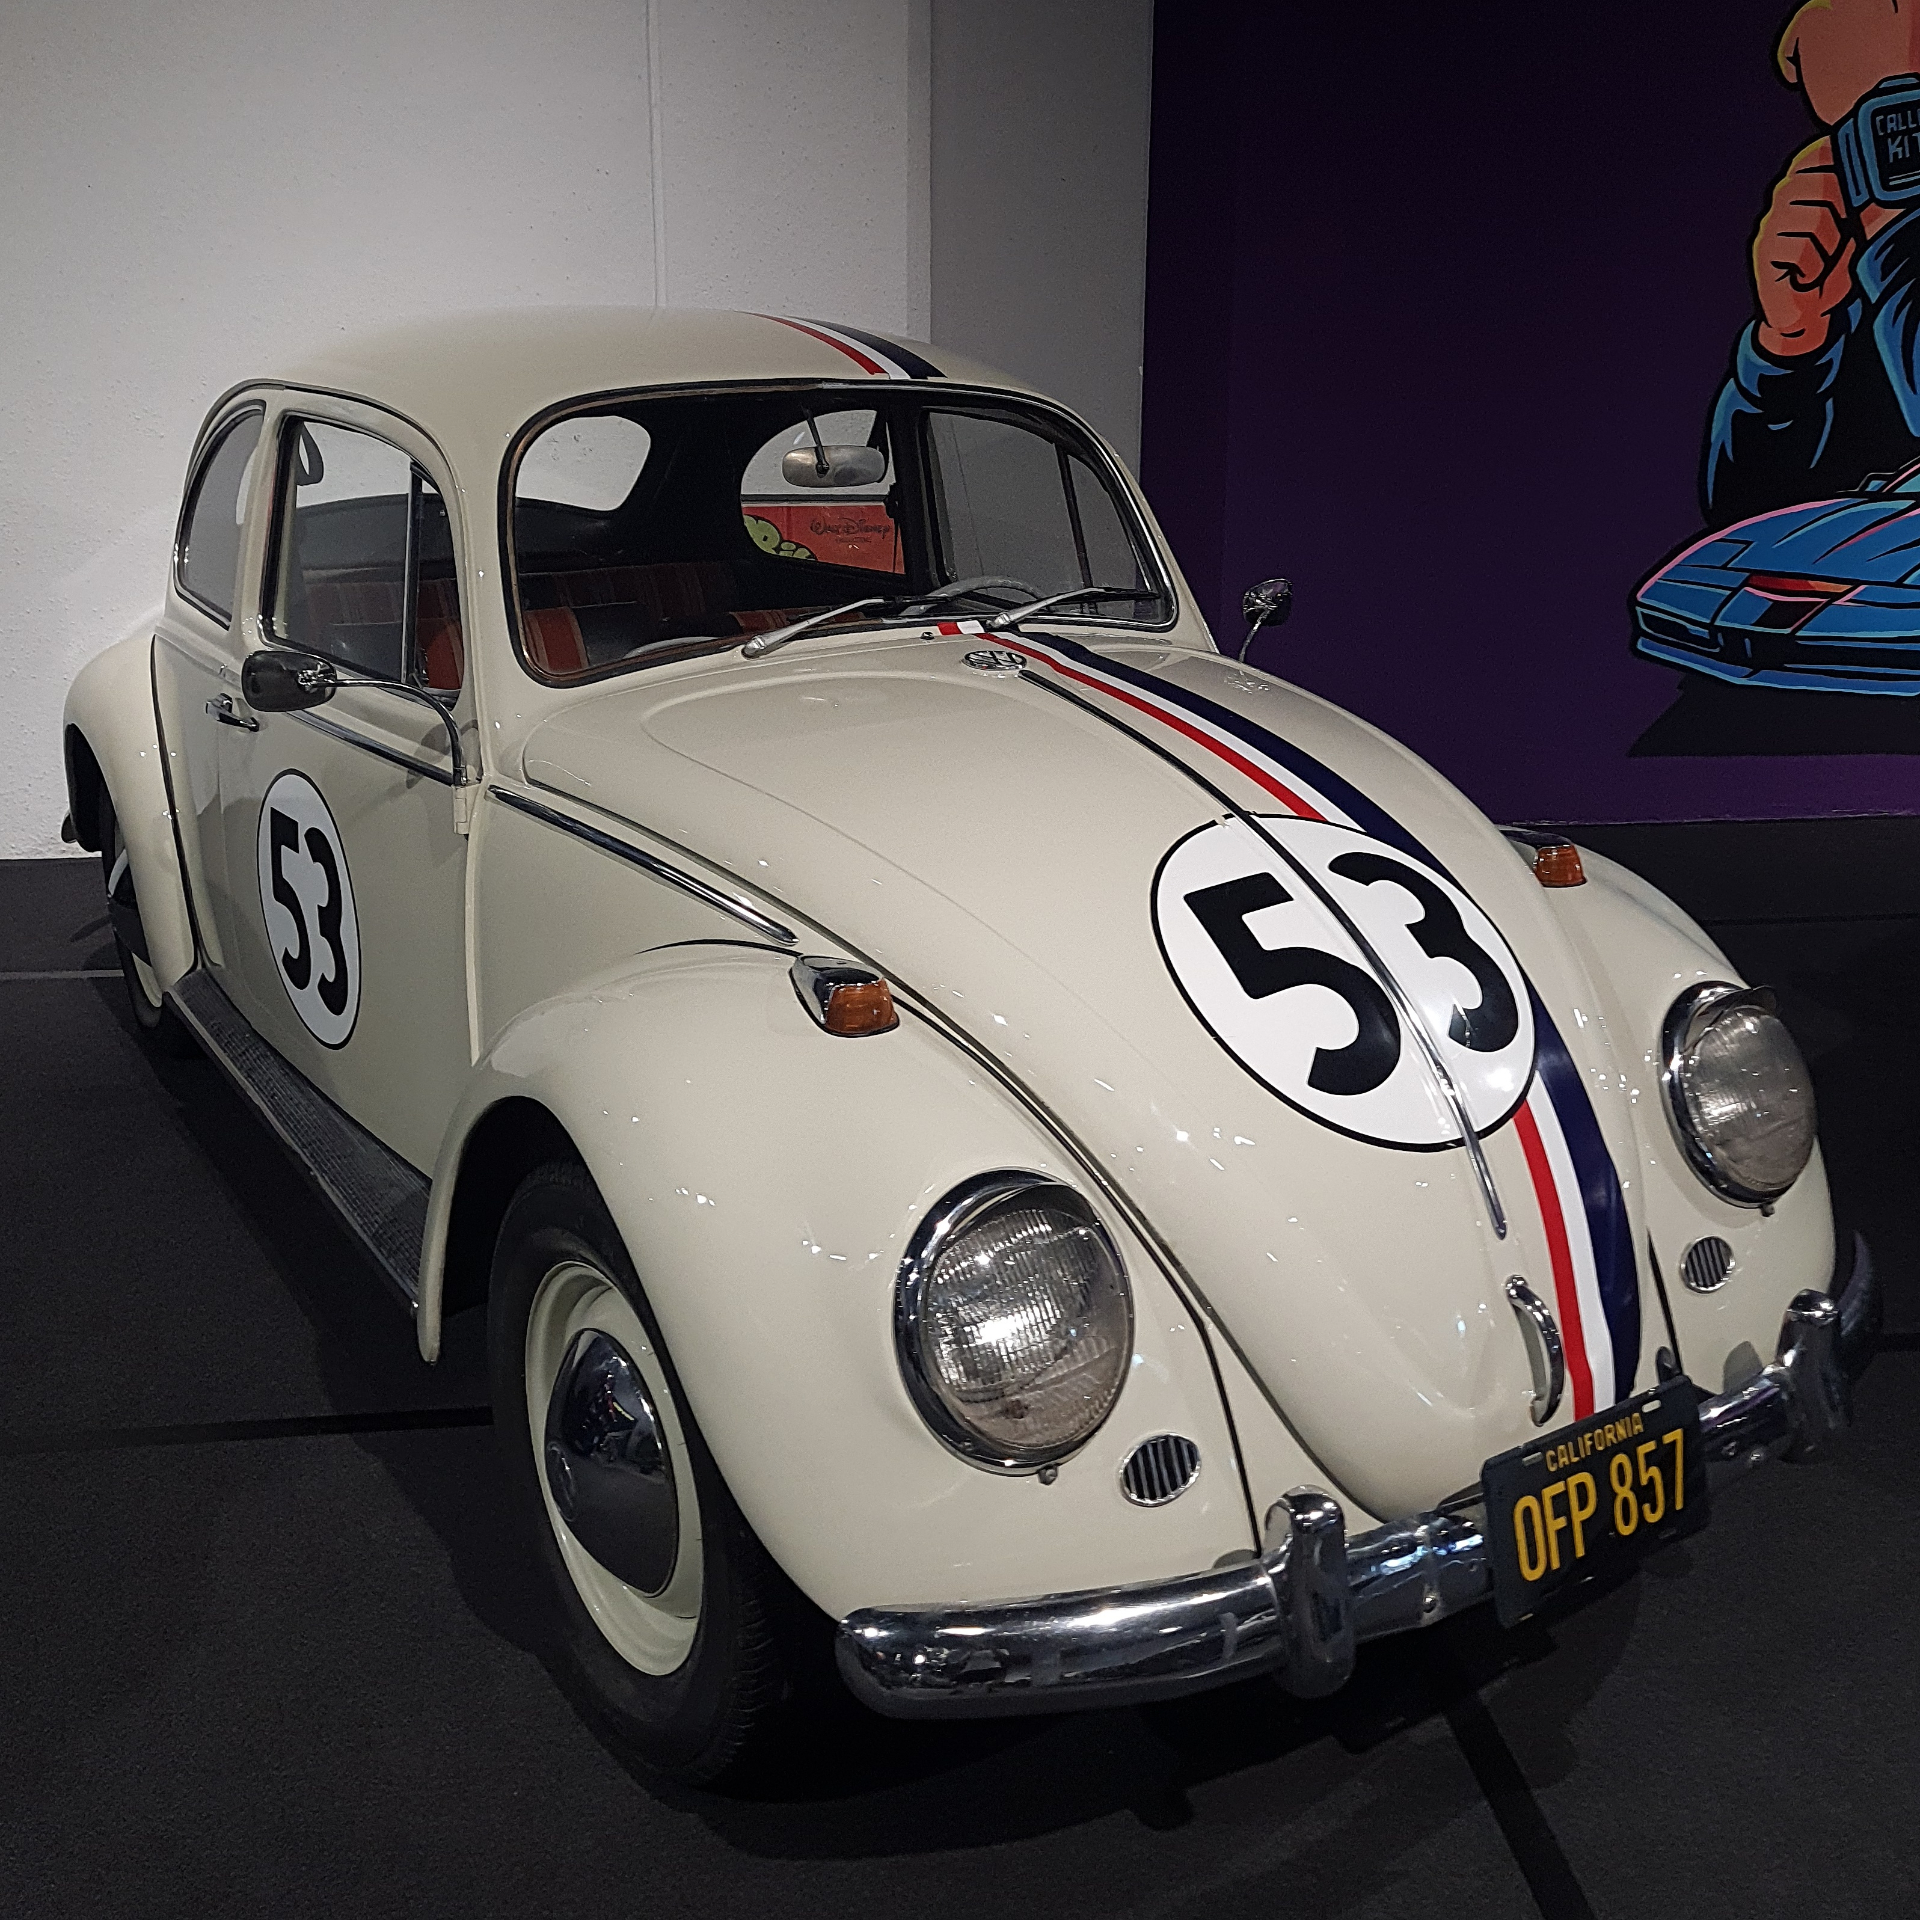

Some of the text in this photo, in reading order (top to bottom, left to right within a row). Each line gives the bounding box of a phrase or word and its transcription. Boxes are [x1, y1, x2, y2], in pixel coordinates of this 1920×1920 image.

[270, 806, 349, 1016] 53
[1183, 851, 1519, 1096] 53
[1513, 1428, 1684, 1582] OFP 857
[1545, 1412, 1644, 1472] CALIFORNIA
